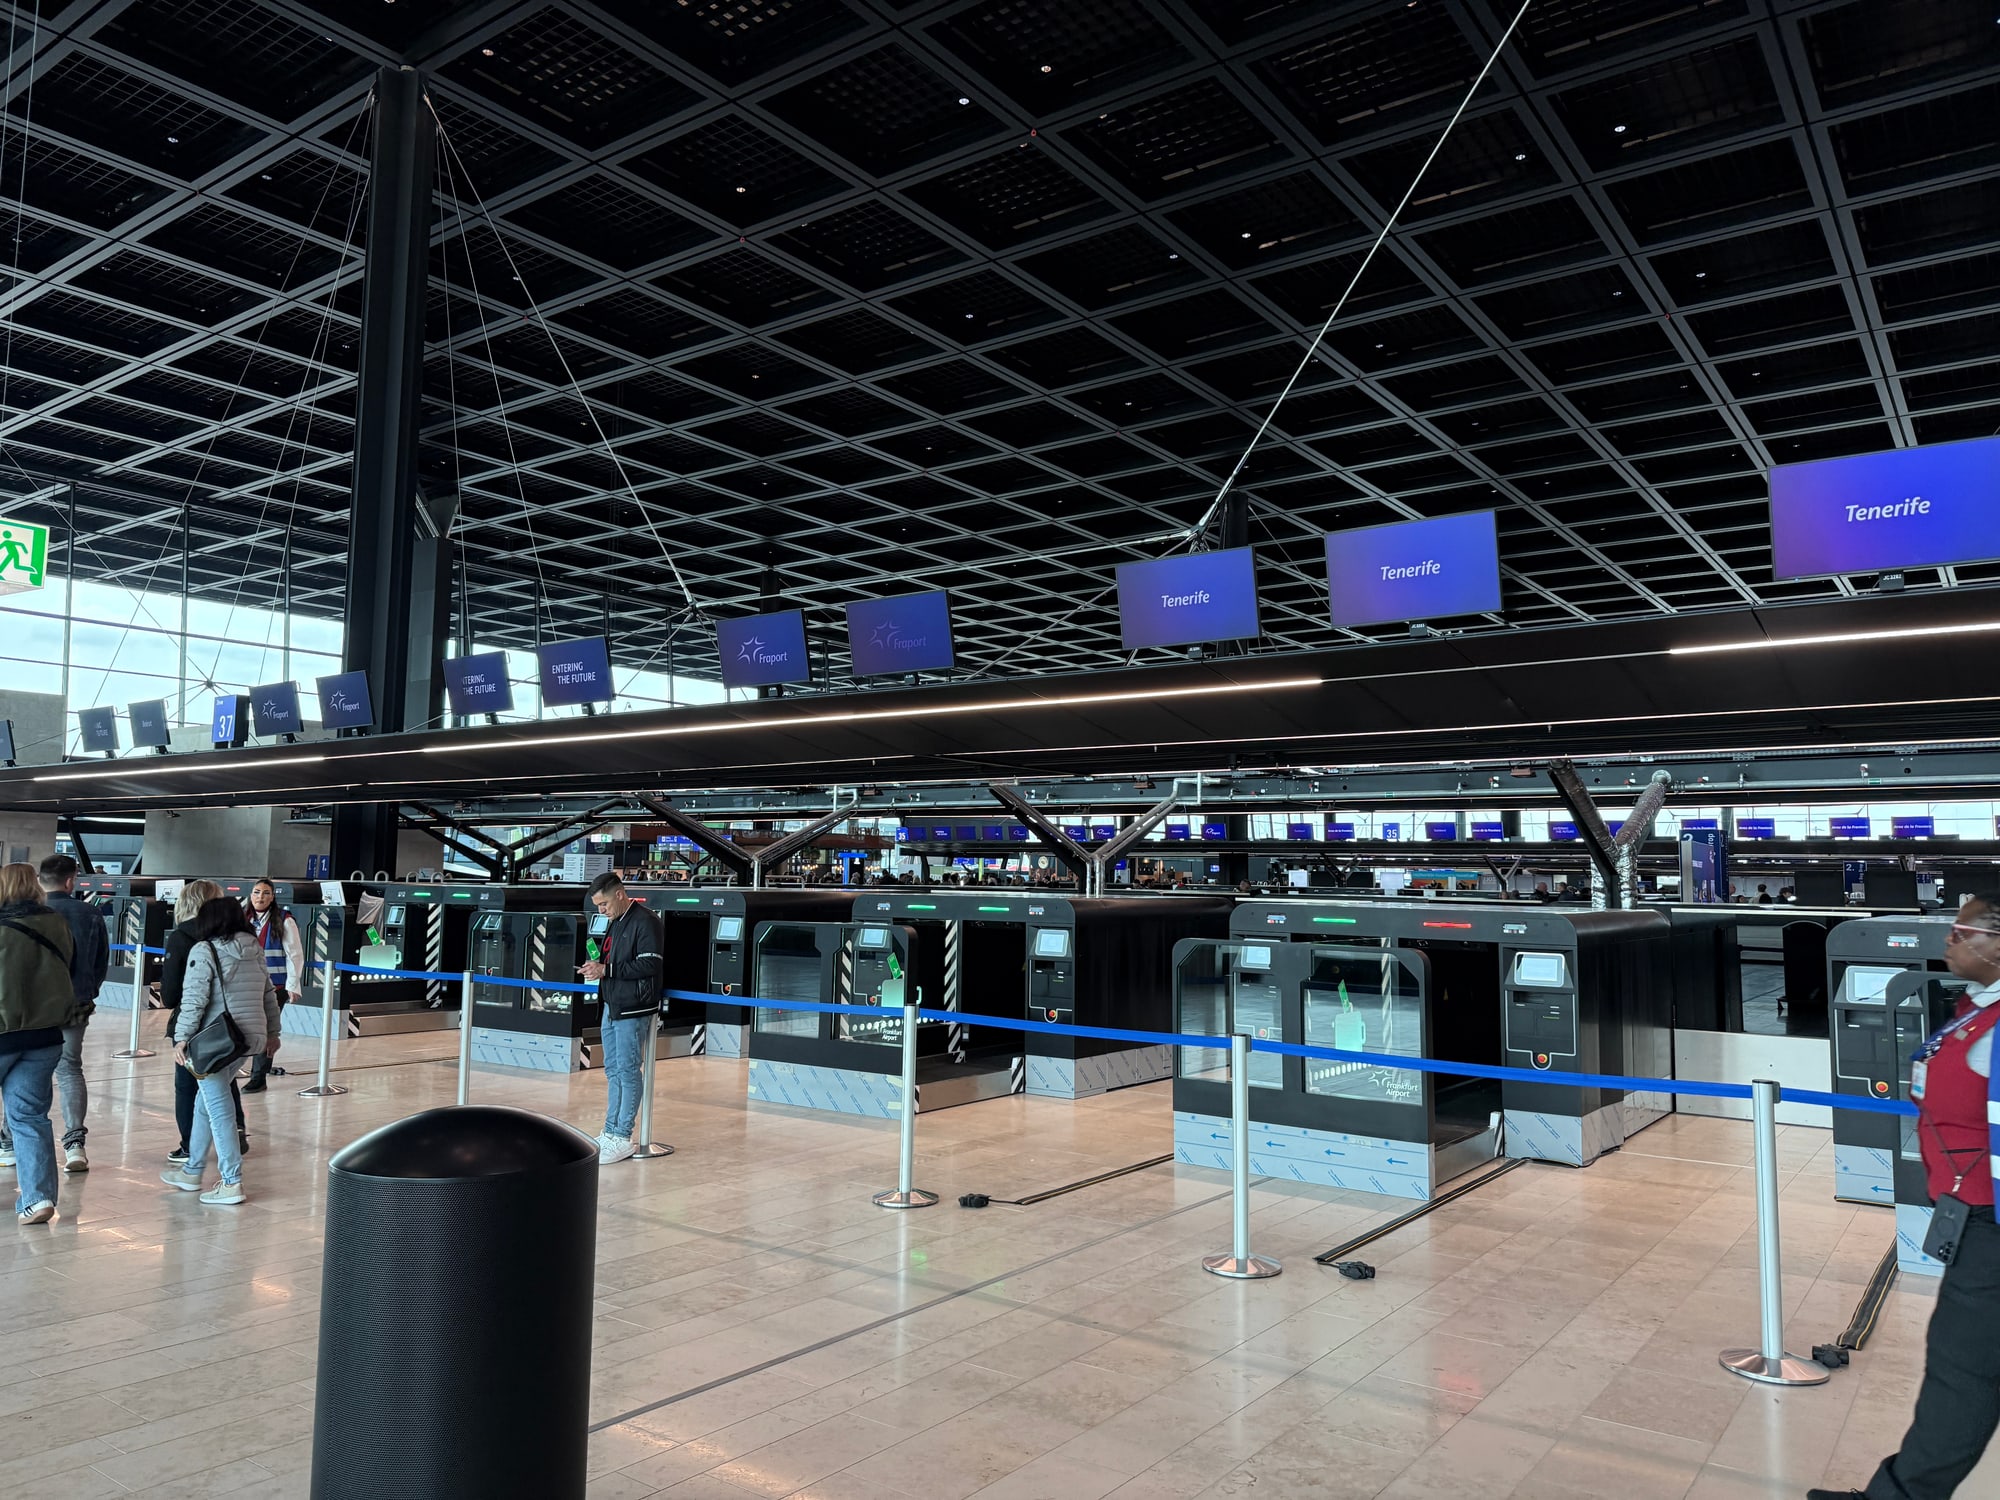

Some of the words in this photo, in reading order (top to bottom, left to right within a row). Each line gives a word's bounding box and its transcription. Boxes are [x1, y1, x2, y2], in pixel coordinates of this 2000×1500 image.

[1845, 496, 1931, 522] Tenerife
[1380, 559, 1441, 581] Tenerife
[1161, 590, 1210, 608] Tenerife
[894, 636, 927, 652] Fraport
[759, 651, 788, 666] Fraport
[552, 661, 584, 675] ENTERING
[557, 674, 570, 685] THE
[571, 671, 596, 684] FUTURE
[474, 682, 497, 695] FUTURE
[341, 701, 360, 713] Fraport
[218, 714, 234, 739] 37
[1386, 829, 1397, 838] 35
[1385, 1088, 1410, 1099] Airport
[1386, 1081, 1418, 1092] Frankfurt
